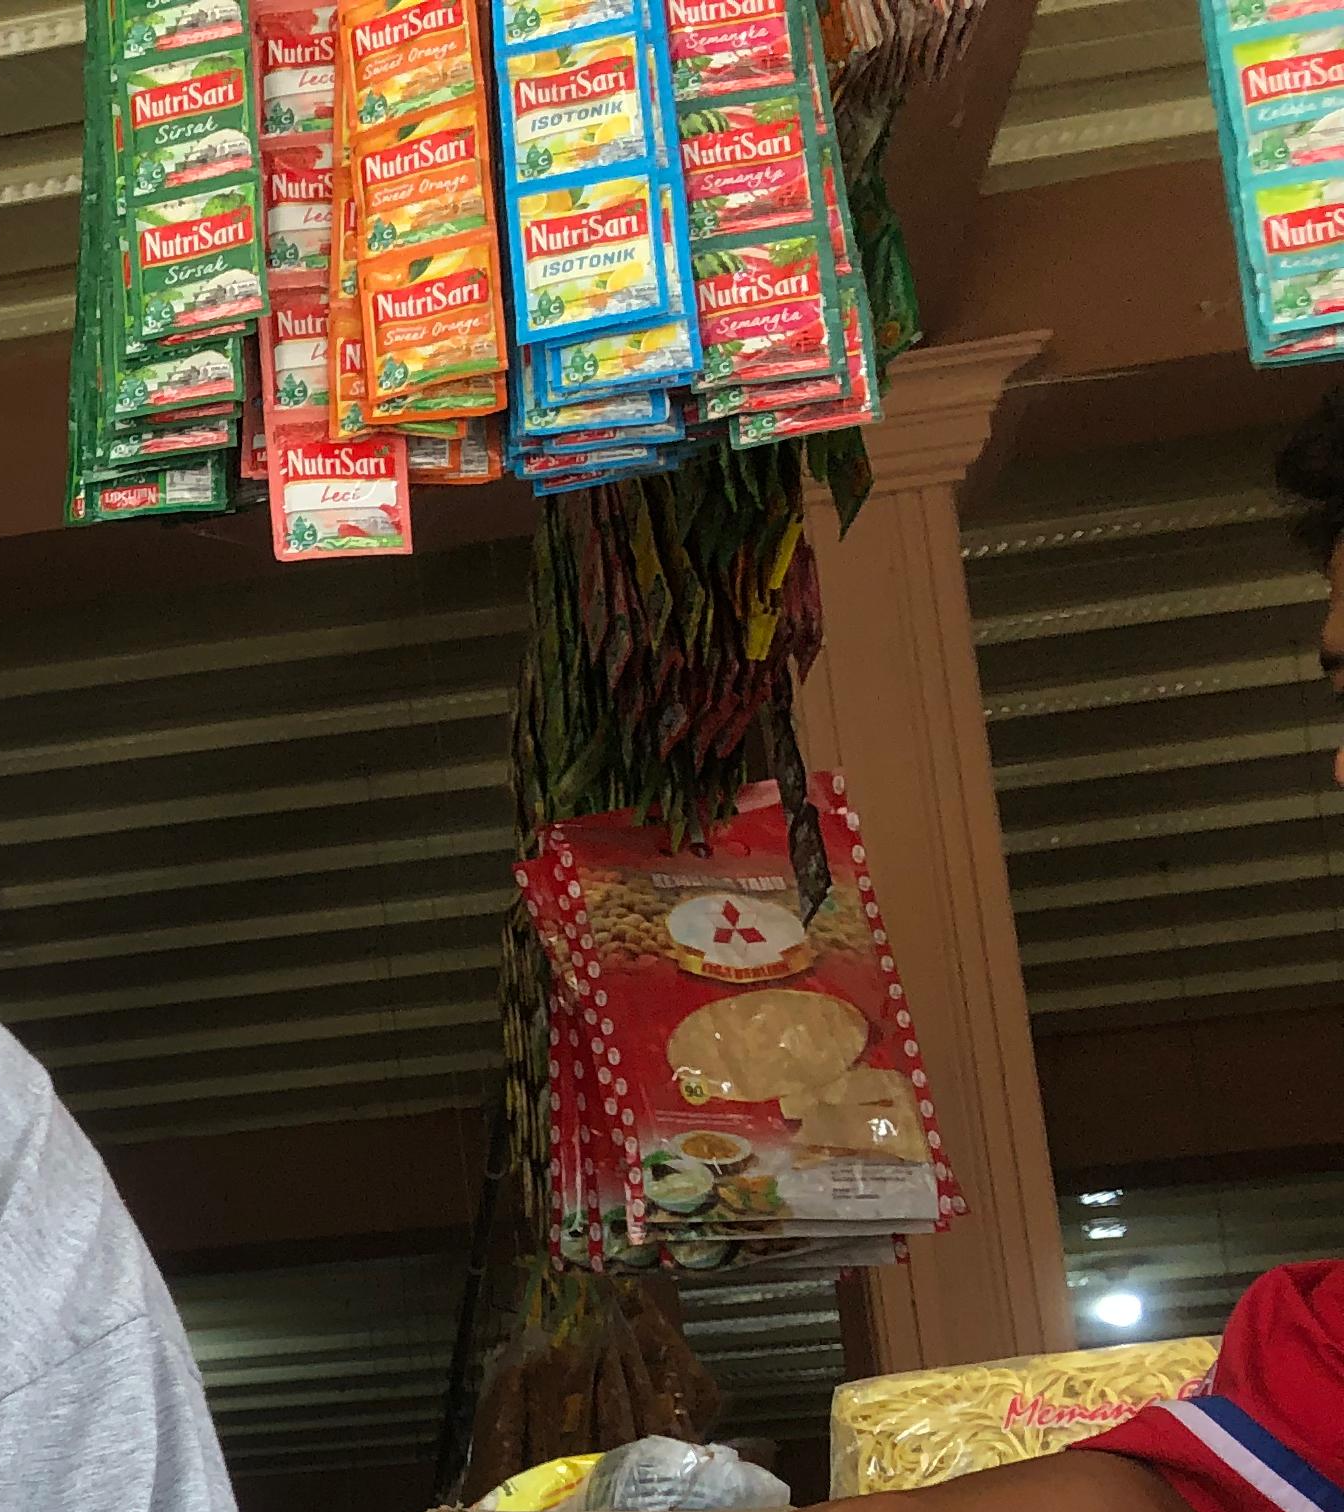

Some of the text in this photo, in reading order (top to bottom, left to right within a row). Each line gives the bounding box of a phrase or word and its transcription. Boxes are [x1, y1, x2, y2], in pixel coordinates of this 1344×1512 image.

[355, 7, 455, 56] NutriSari
[685, 23, 769, 49] Semangka
[408, 41, 457, 62] Orange
[135, 83, 235, 122] NutriSari
[519, 70, 626, 109] NutriSari
[155, 116, 219, 144] Sirsak
[530, 100, 623, 132] ISOTONIK
[364, 139, 466, 184] NutriSari
[682, 132, 791, 169] NutriSari
[419, 175, 468, 194] Orange
[144, 222, 244, 261] NutriSari
[530, 214, 639, 253] NutriSari
[164, 255, 228, 284] Sirsak
[542, 247, 635, 278] ISOTONIK
[377, 282, 480, 321] NutriSari
[699, 273, 809, 312] NutriSari
[383, 317, 481, 347] Sweet Orange
[716, 307, 803, 334] Semangka
[286, 448, 387, 478] NutriSari
[321, 485, 361, 503] Leci
